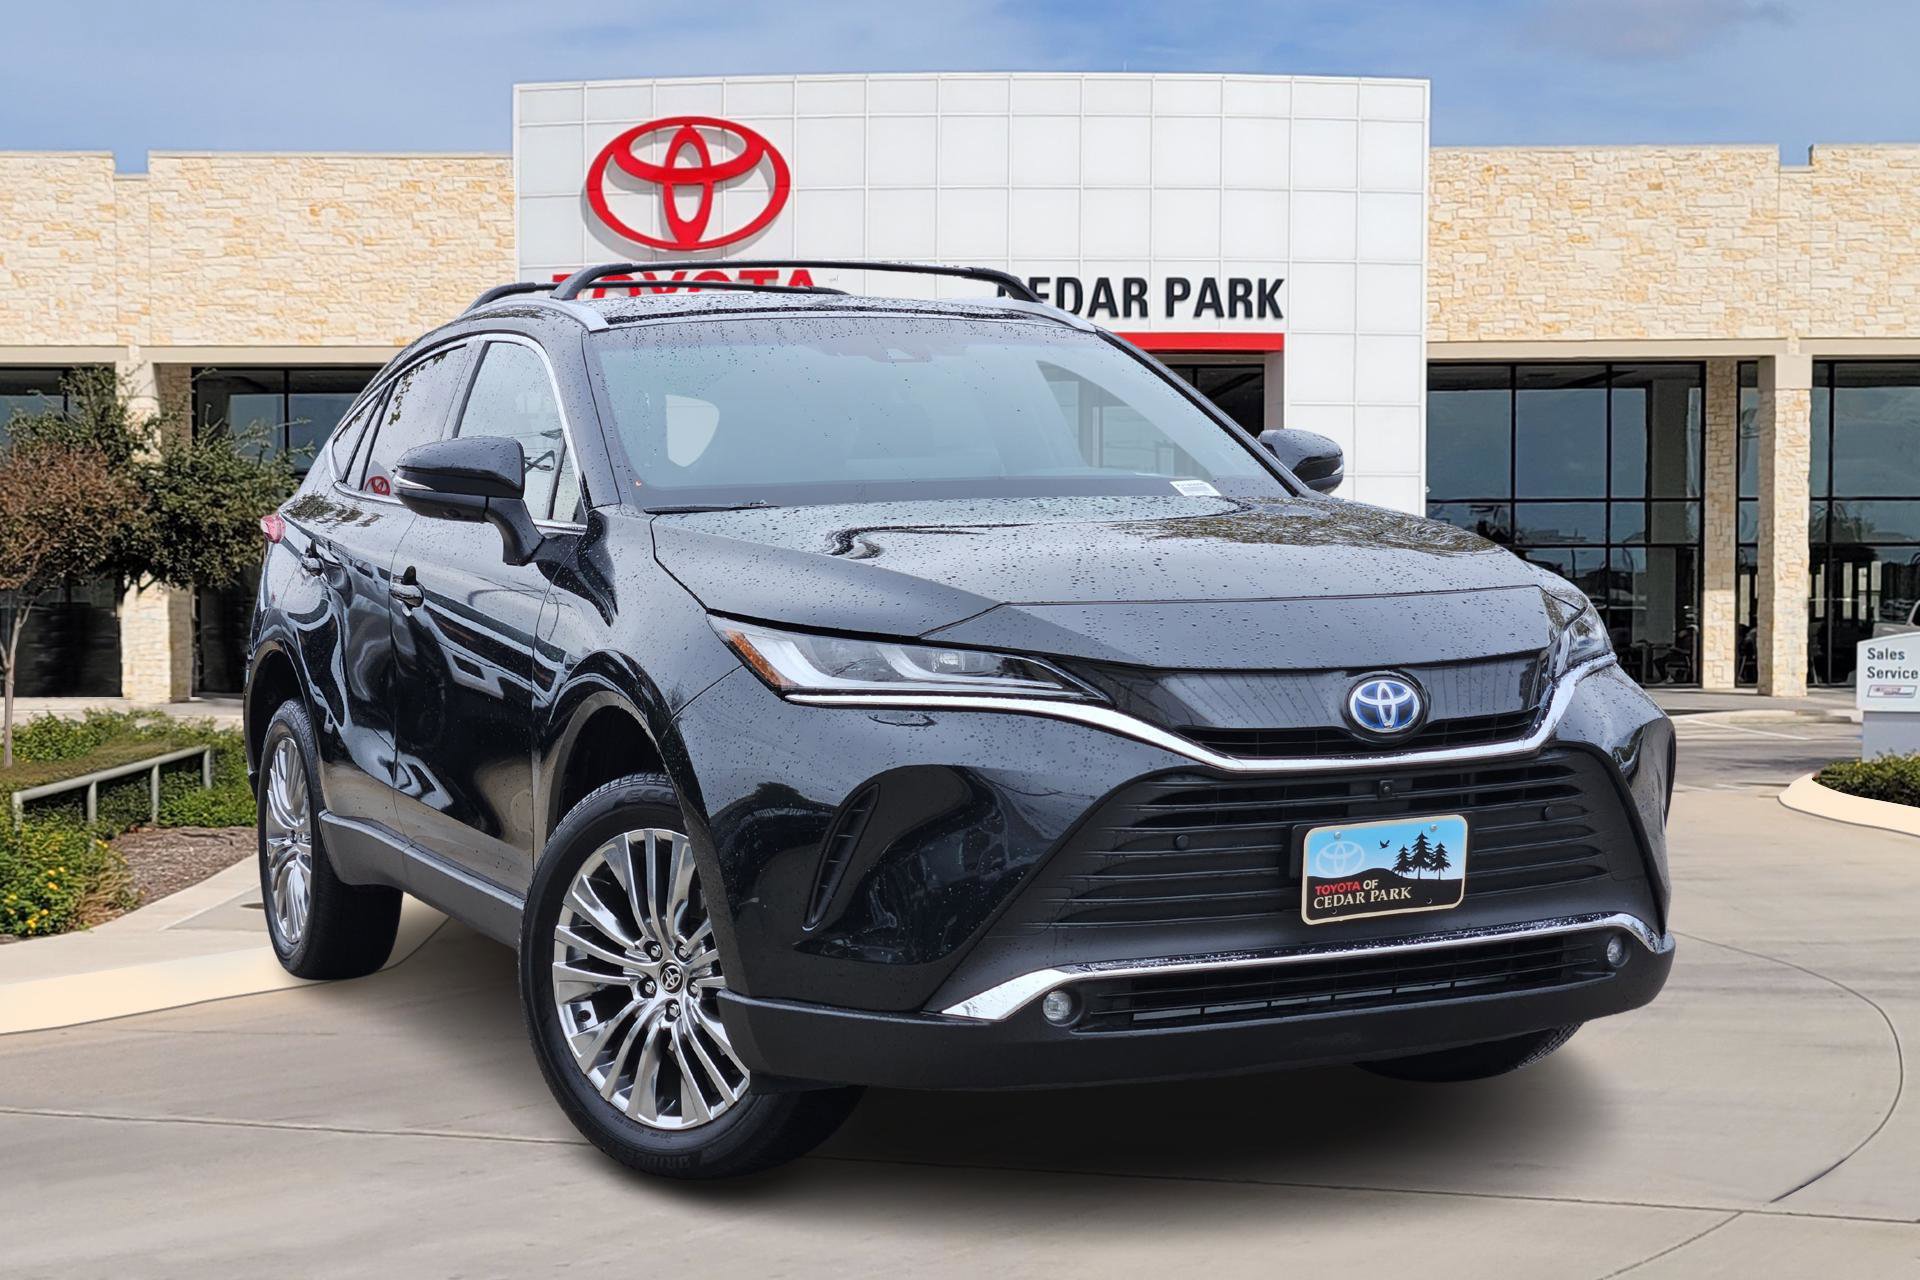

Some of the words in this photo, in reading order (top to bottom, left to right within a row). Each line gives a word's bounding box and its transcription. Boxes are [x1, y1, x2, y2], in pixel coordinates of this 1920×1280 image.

[997, 277, 1148, 318] EDAR
[1165, 277, 1285, 318] PARK
[1867, 647, 1905, 660] Sales
[1867, 666, 1919, 679] Service
[1315, 881, 1360, 896] TOYOTA
[1363, 880, 1379, 890] OF
[1313, 891, 1366, 909] CEDAR
[1369, 886, 1412, 902] PARK
